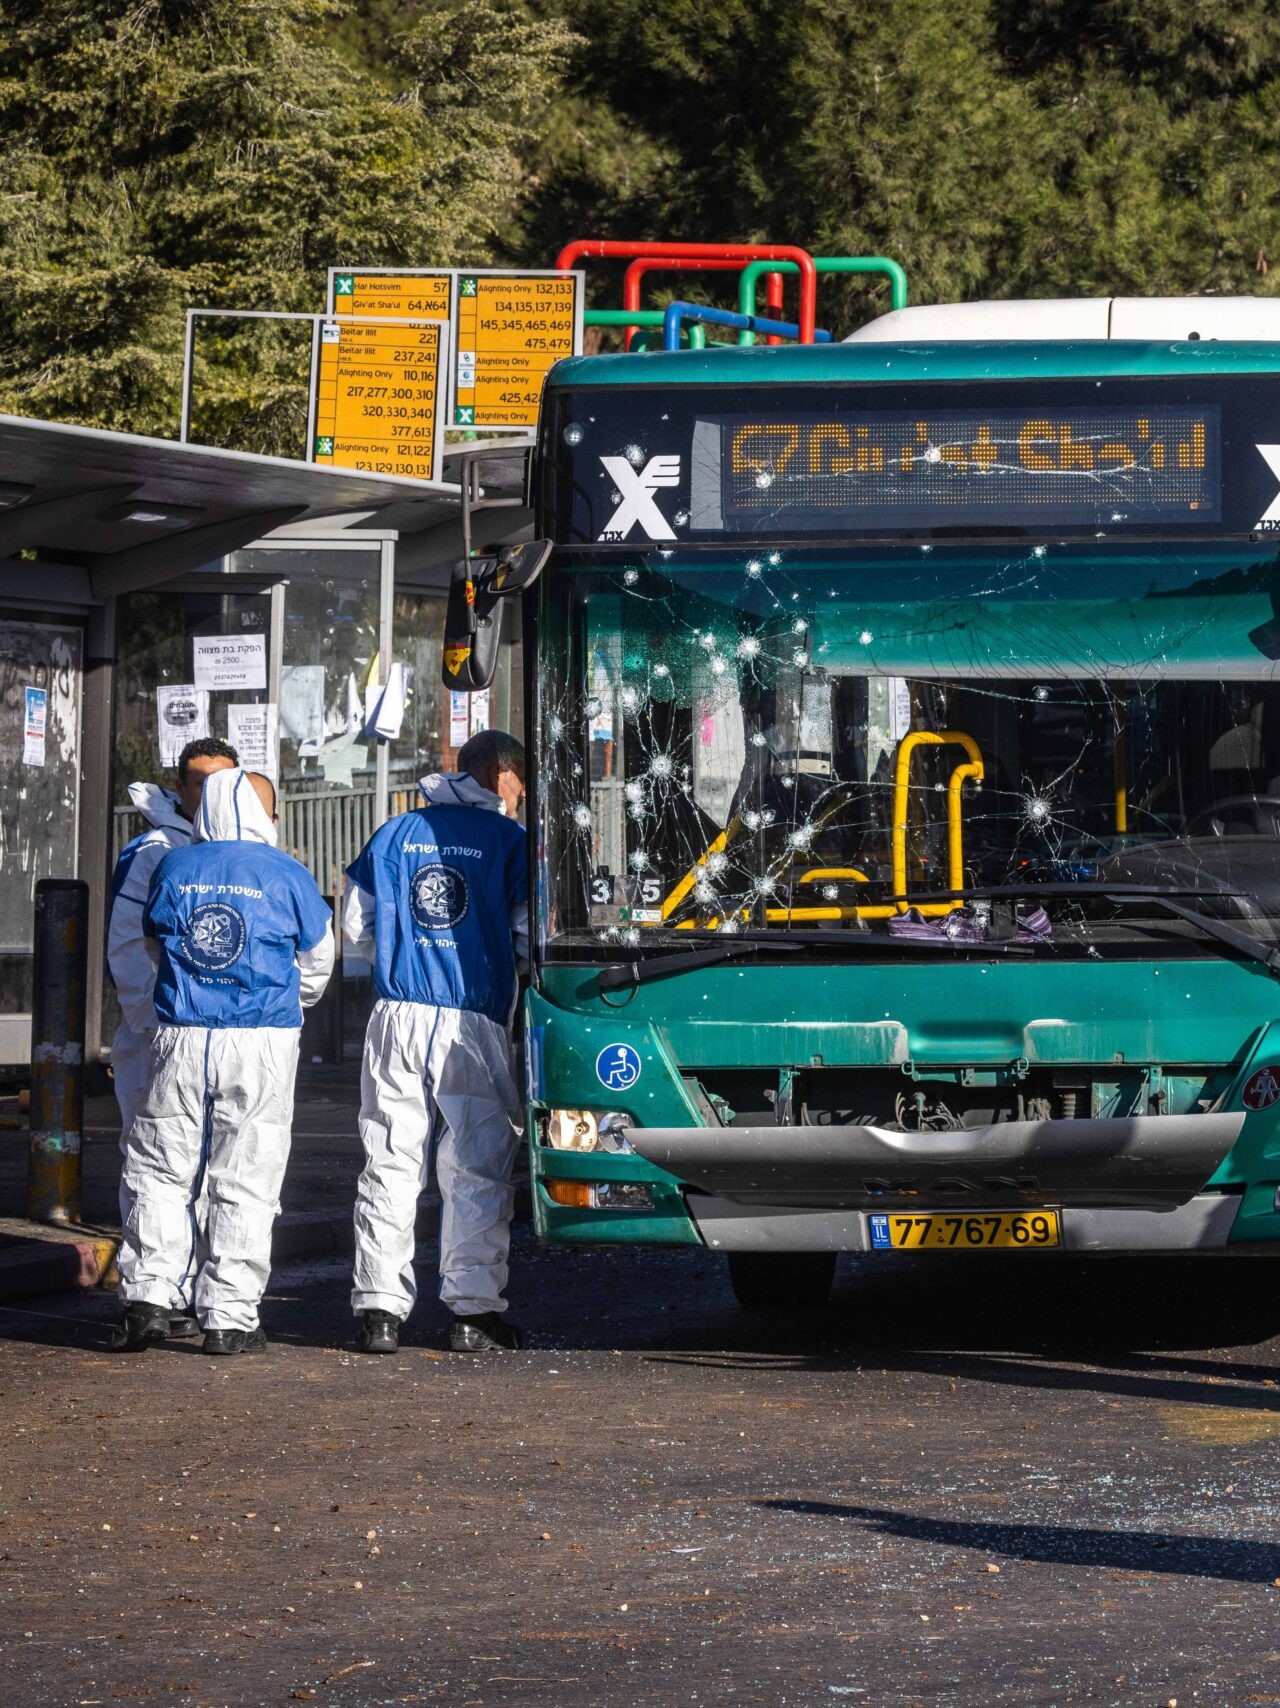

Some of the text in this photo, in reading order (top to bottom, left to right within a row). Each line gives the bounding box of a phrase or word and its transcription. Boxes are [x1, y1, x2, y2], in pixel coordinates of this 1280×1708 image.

[434, 282, 448, 292] 57
[478, 284, 572, 296] Alighting Only 132,133
[495, 302, 572, 314] 134,135,137,139
[480, 320, 571, 332] 145,345,465,469
[419, 334, 436, 344] 221
[525, 339, 570, 350] 475,479
[340, 346, 362, 354] Beitar
[394, 352, 436, 364] 237,241
[476, 358, 509, 366] Alighting
[512, 358, 529, 366] Only
[338, 369, 434, 382] Alighting Only 110,116
[476, 376, 509, 384] Alighting
[511, 376, 528, 384] Only
[347, 386, 434, 400] 217,277,300,310
[362, 406, 432, 419] 320,330,340
[476, 412, 528, 420] Alighting Only
[391, 426, 432, 438] 377,613
[335, 443, 430, 458] Alighting Only 121,122
[404, 841, 438, 854] ישראל
[180, 884, 262, 899] משטרת ישראל
[592, 880, 660, 902] 3 5
[876, 1225, 886, 1238] IL
